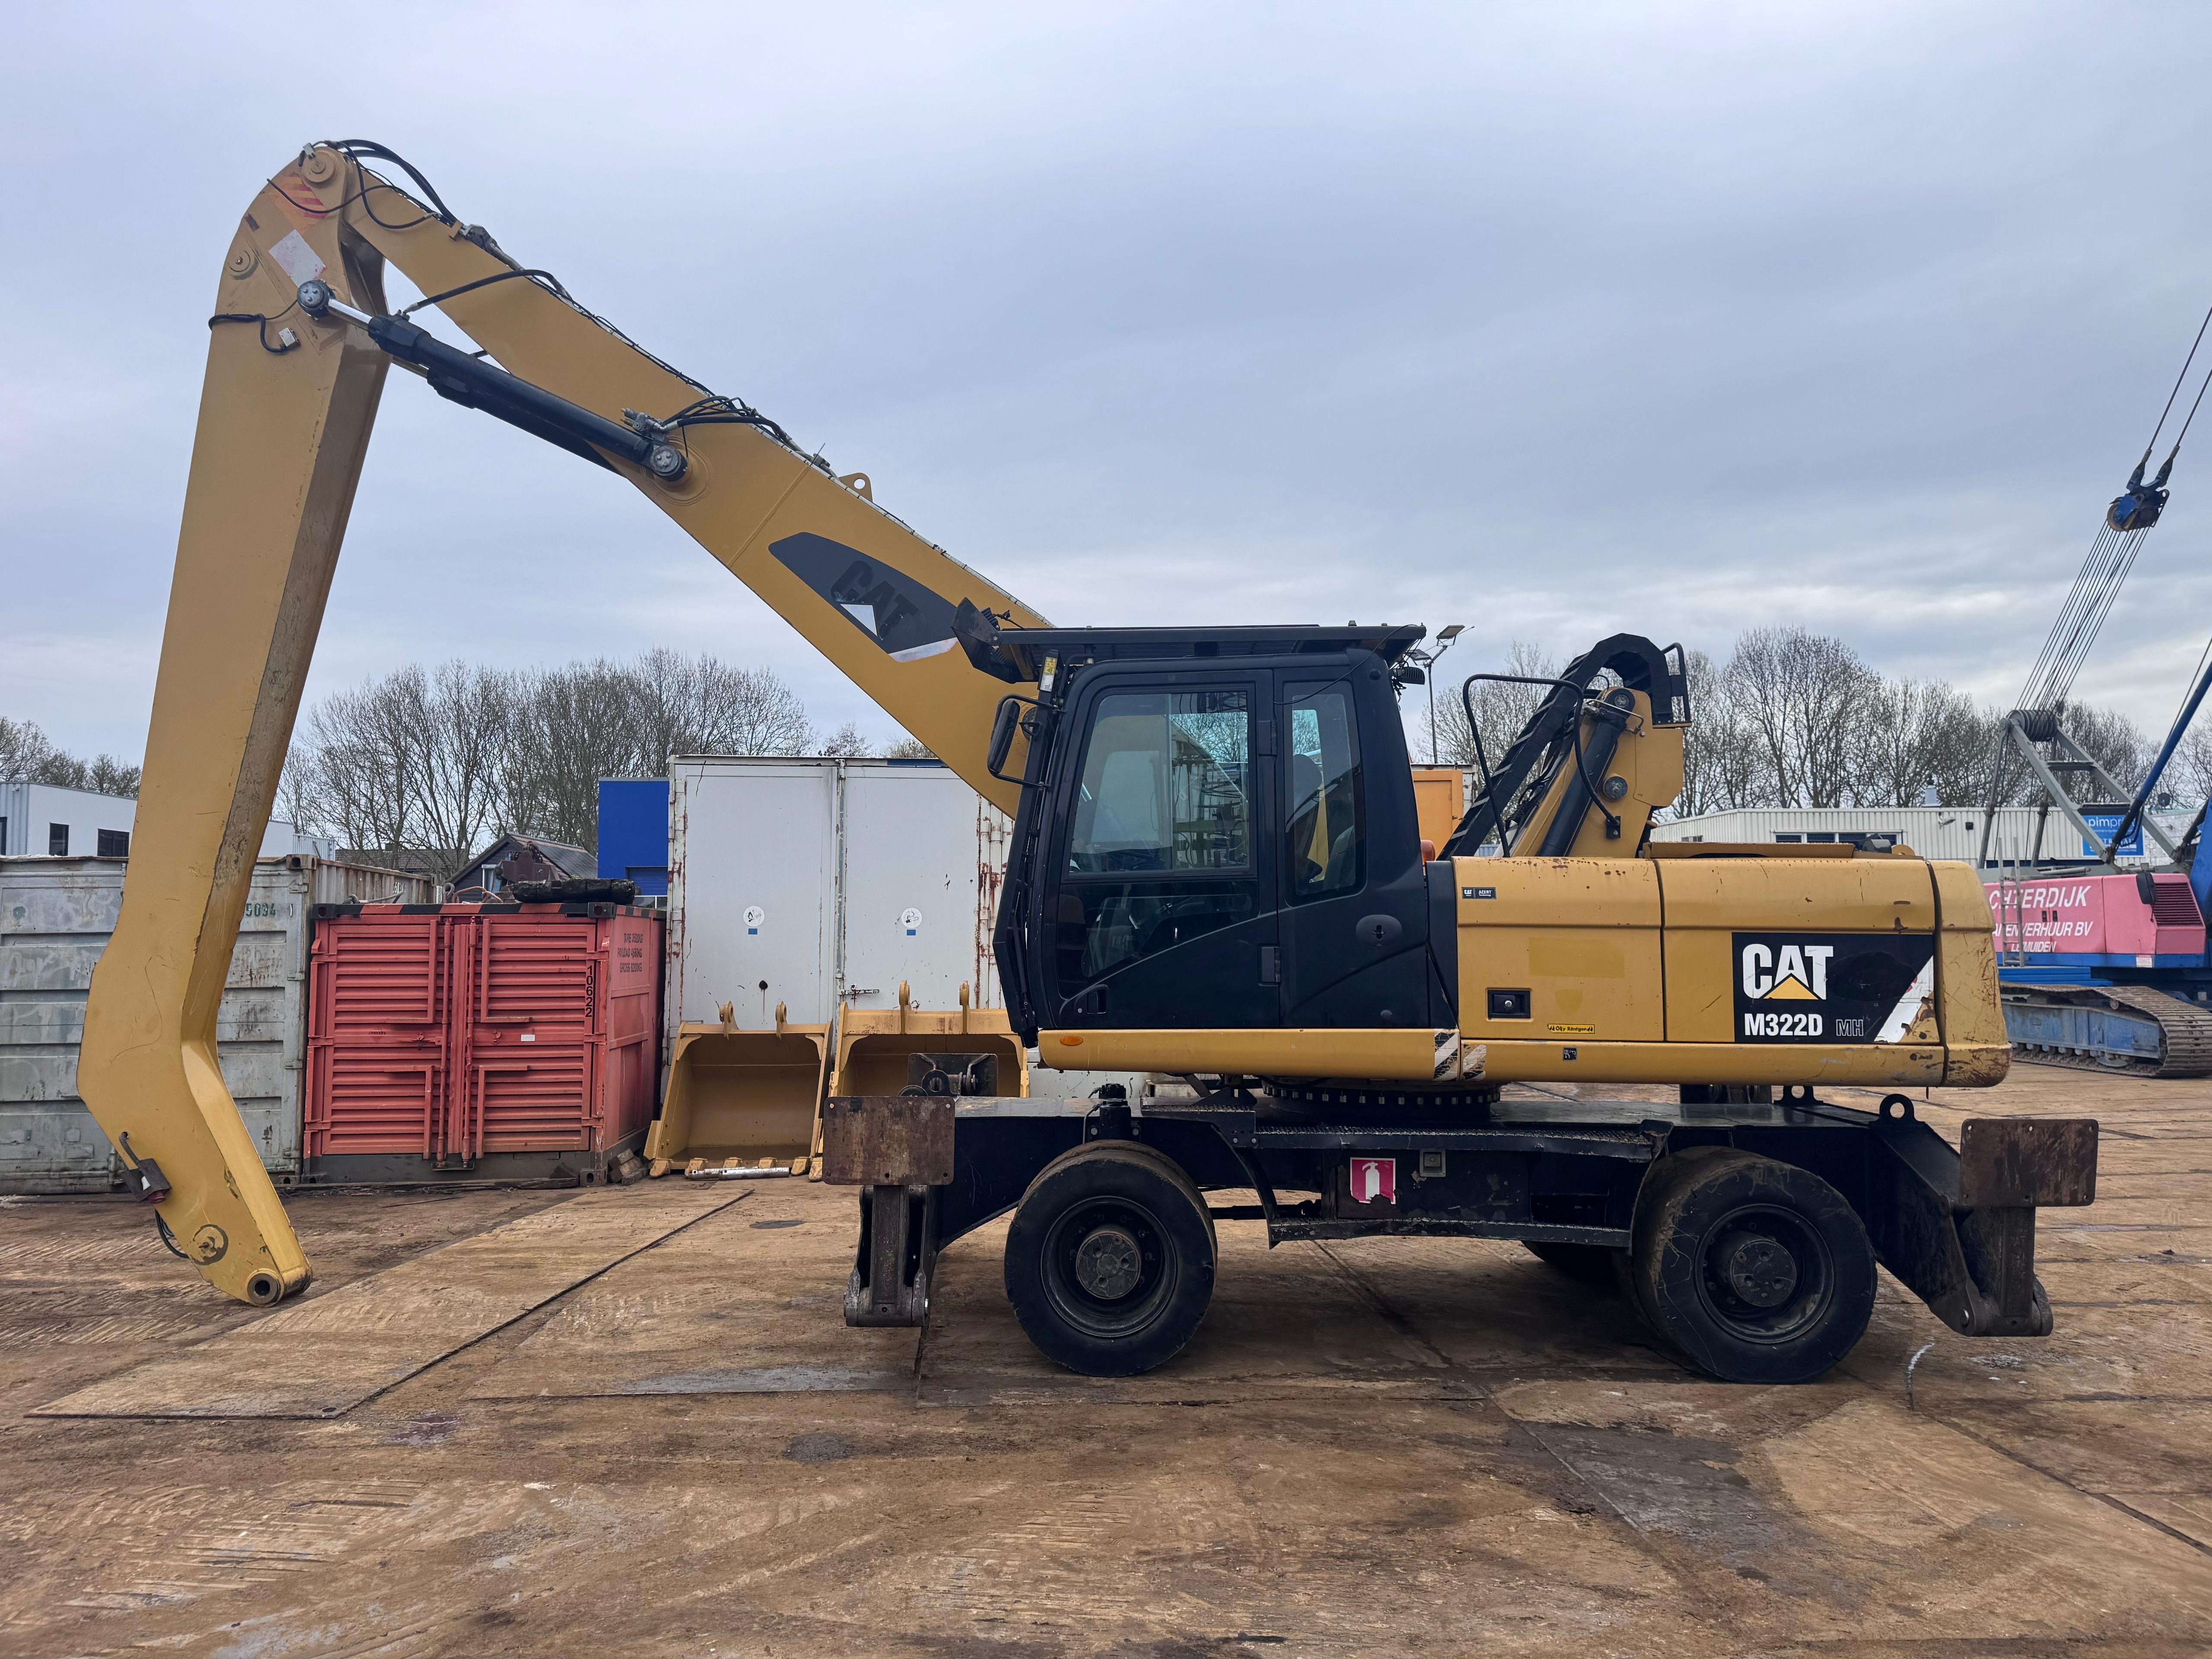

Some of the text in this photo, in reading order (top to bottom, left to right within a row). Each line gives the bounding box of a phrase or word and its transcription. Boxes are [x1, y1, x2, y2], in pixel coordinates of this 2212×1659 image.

[830, 560, 919, 641] CAT
[2088, 816, 2136, 828] pimpr
[1989, 886, 2092, 910] CHTERDIJK
[2074, 921, 2094, 937] BV
[2011, 941, 2056, 953] LEMUIDEN
[1742, 944, 1834, 1000] CAT
[585, 965, 593, 1017] 10622
[1744, 1013, 1864, 1036] M322D MH
